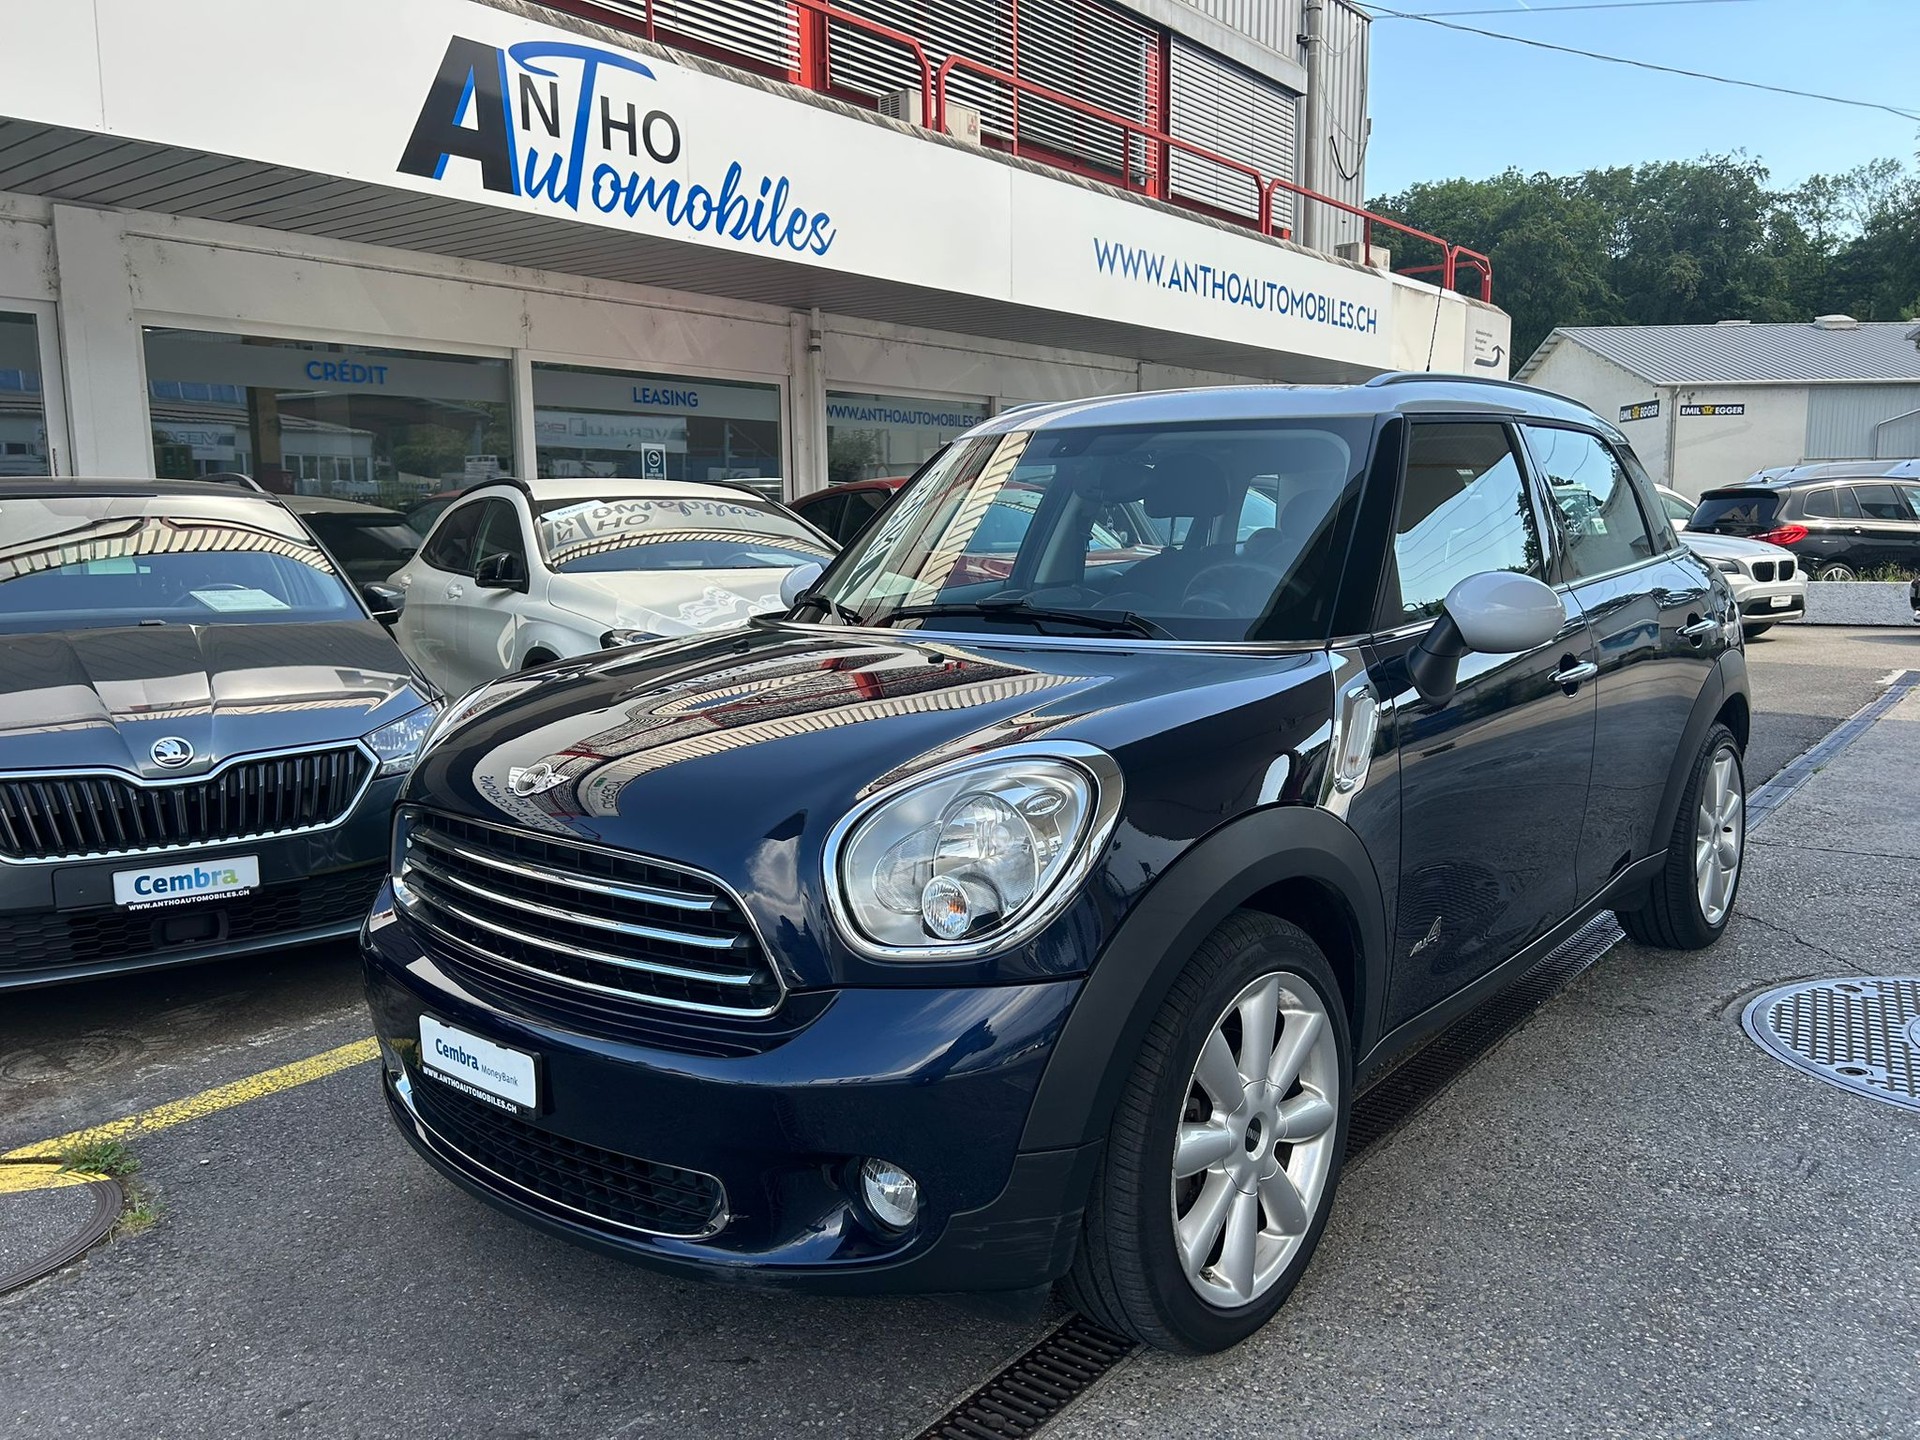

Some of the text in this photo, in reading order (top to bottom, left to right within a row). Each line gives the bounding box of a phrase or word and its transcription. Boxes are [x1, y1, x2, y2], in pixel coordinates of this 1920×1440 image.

[1093, 237, 1377, 335] WWW.ANTHOAUTOMOBILES.CH
[306, 359, 388, 384] CRÉDIT
[633, 387, 699, 408] LEASING
[1620, 405, 1658, 420] EMIL EGGER
[1681, 406, 1743, 415] EMIL EGGER
[134, 867, 239, 895] Cembra
[128, 889, 250, 911] WWW.ANTHOAUTOMOBILES.CH
[435, 1038, 519, 1086] Cembra MoneyBank
[422, 1065, 517, 1114] WWW.ANTHOAUTOMOBILES.CH
